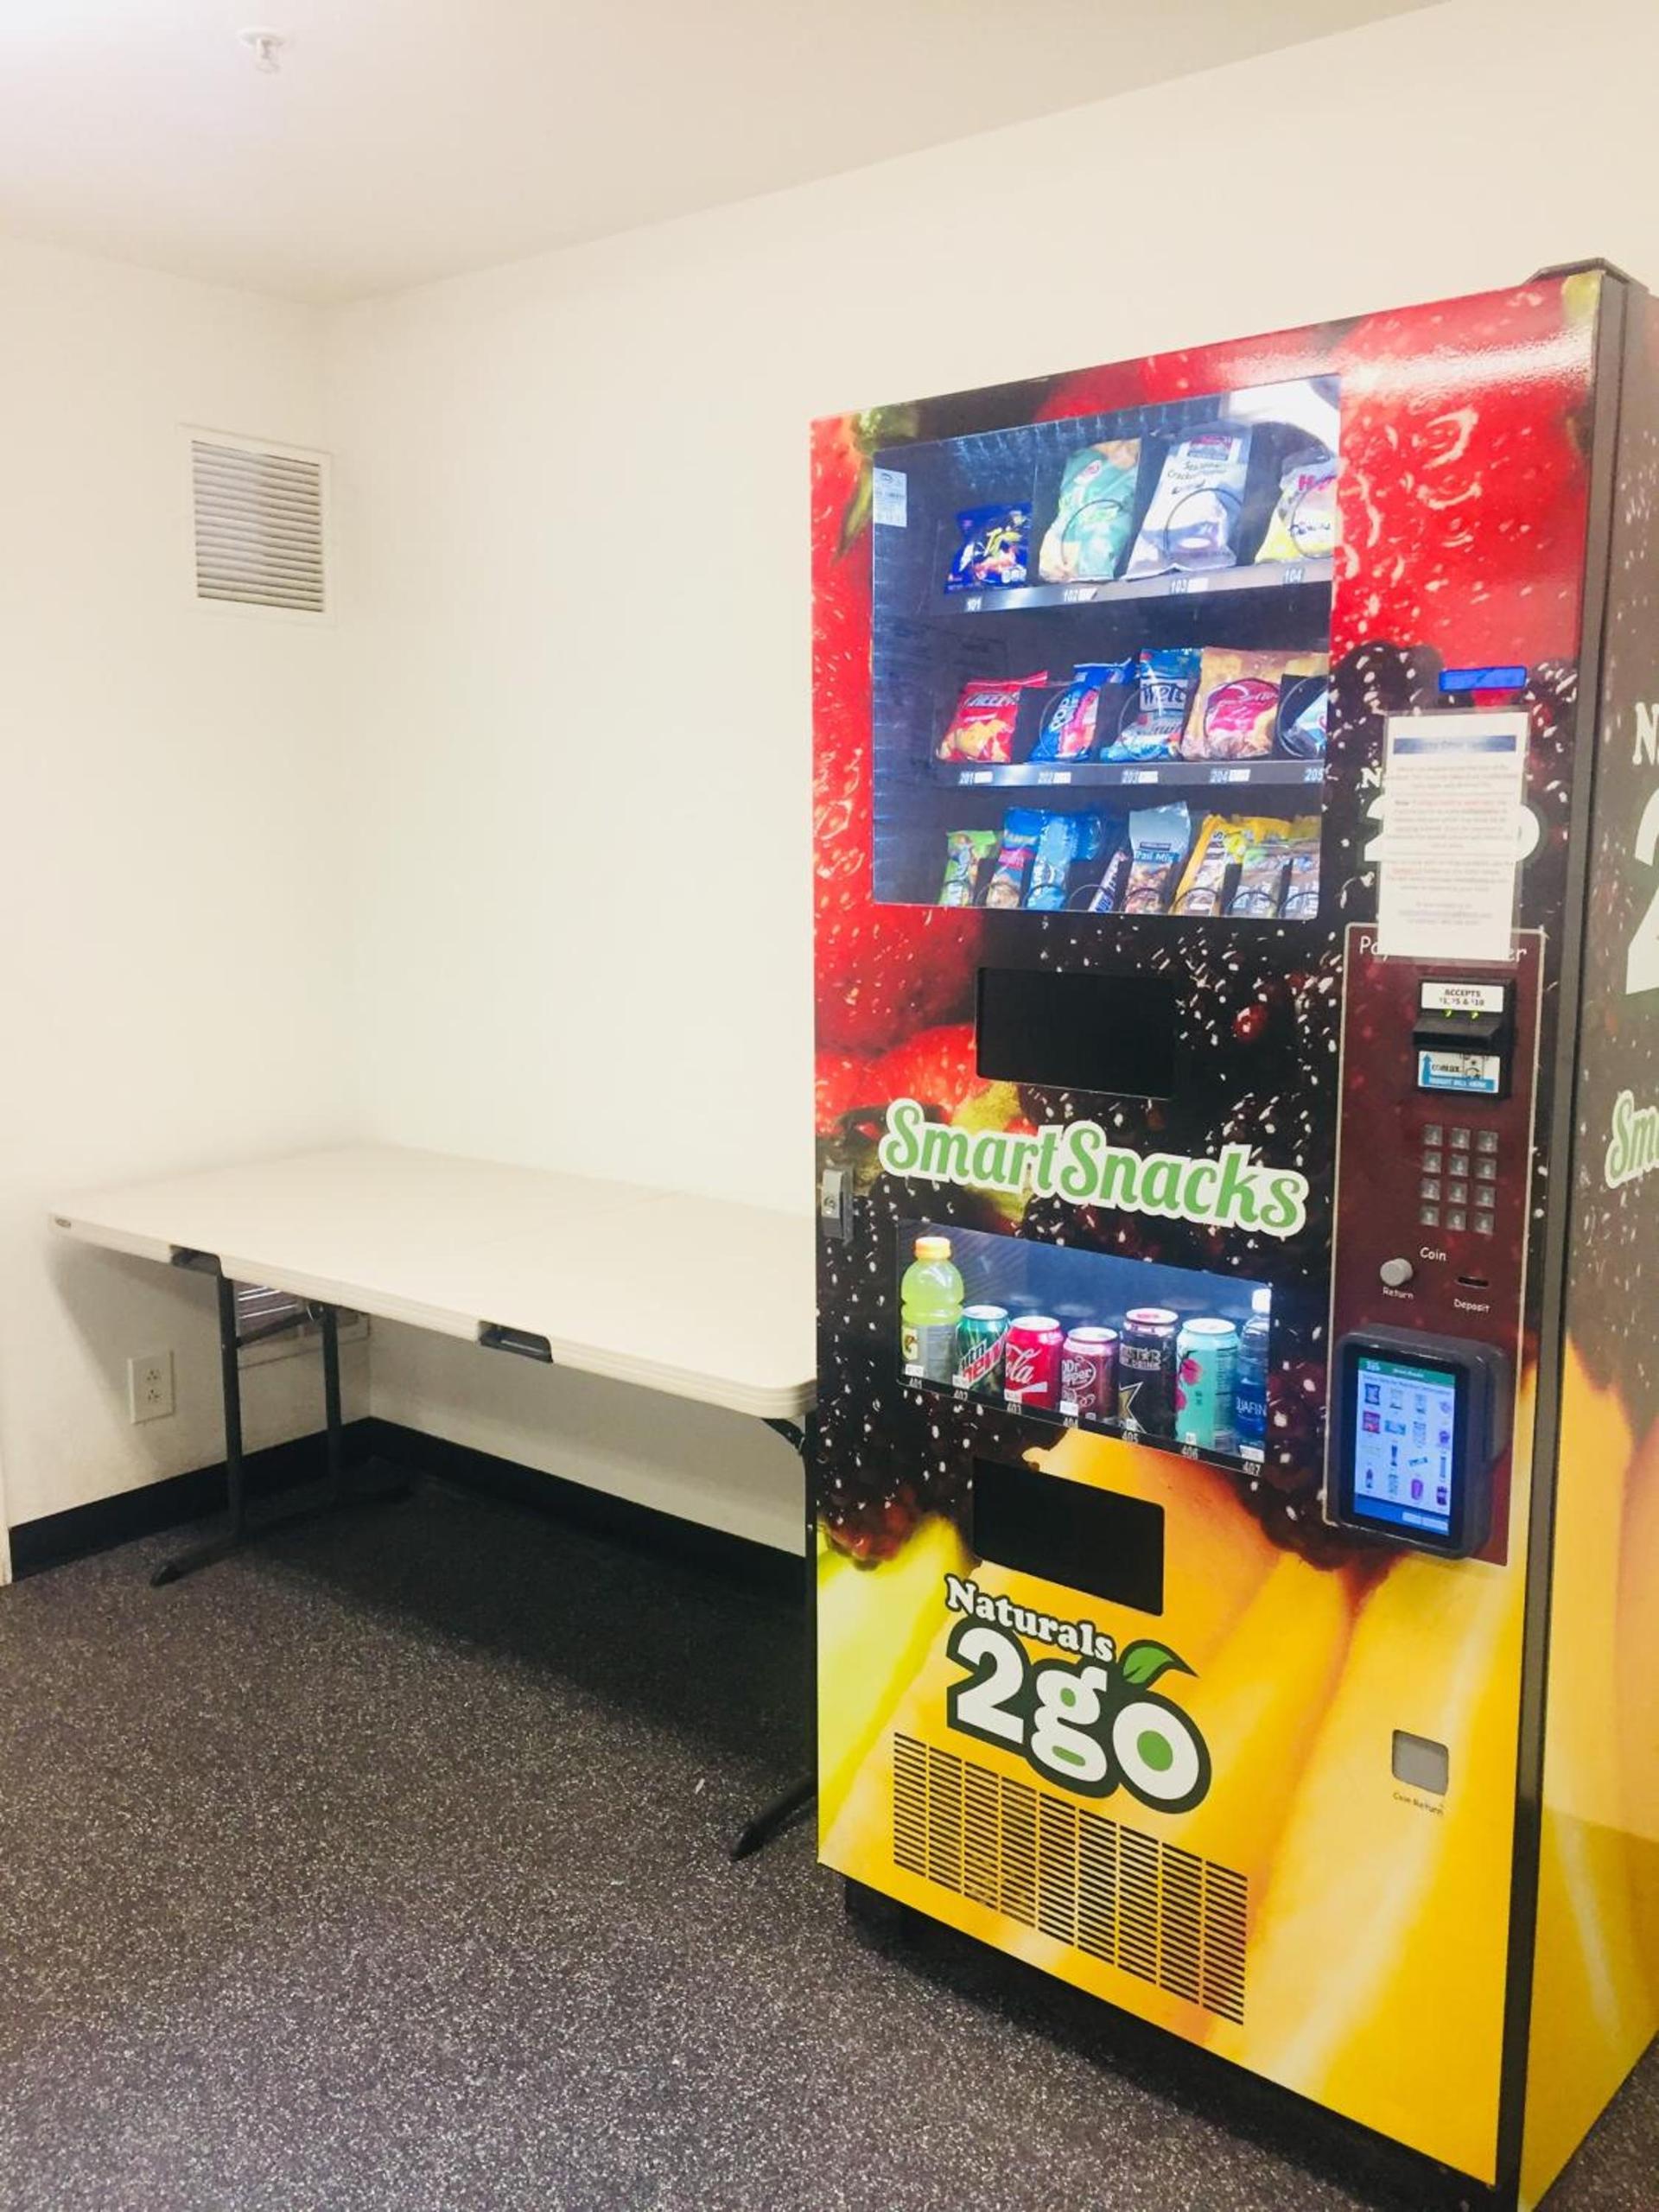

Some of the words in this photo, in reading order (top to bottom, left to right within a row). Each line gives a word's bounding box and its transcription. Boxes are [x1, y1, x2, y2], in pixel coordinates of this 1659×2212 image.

[1444, 988, 1481, 998] ACCEPTS
[881, 1101, 1306, 1234] SmartSnacks
[1420, 1246, 1447, 1262] Coin
[1382, 1286, 1414, 1300] Return
[1453, 1298, 1491, 1313] Deposit
[954, 1389, 968, 1402] 402
[1007, 1402, 1022, 1415] 403
[1122, 1430, 1139, 1444] 405
[1181, 1445, 1198, 1460] 406
[1243, 1460, 1262, 1477] 407
[945, 1576, 1115, 1662] Naturals
[952, 1624, 1203, 1803] 2go
